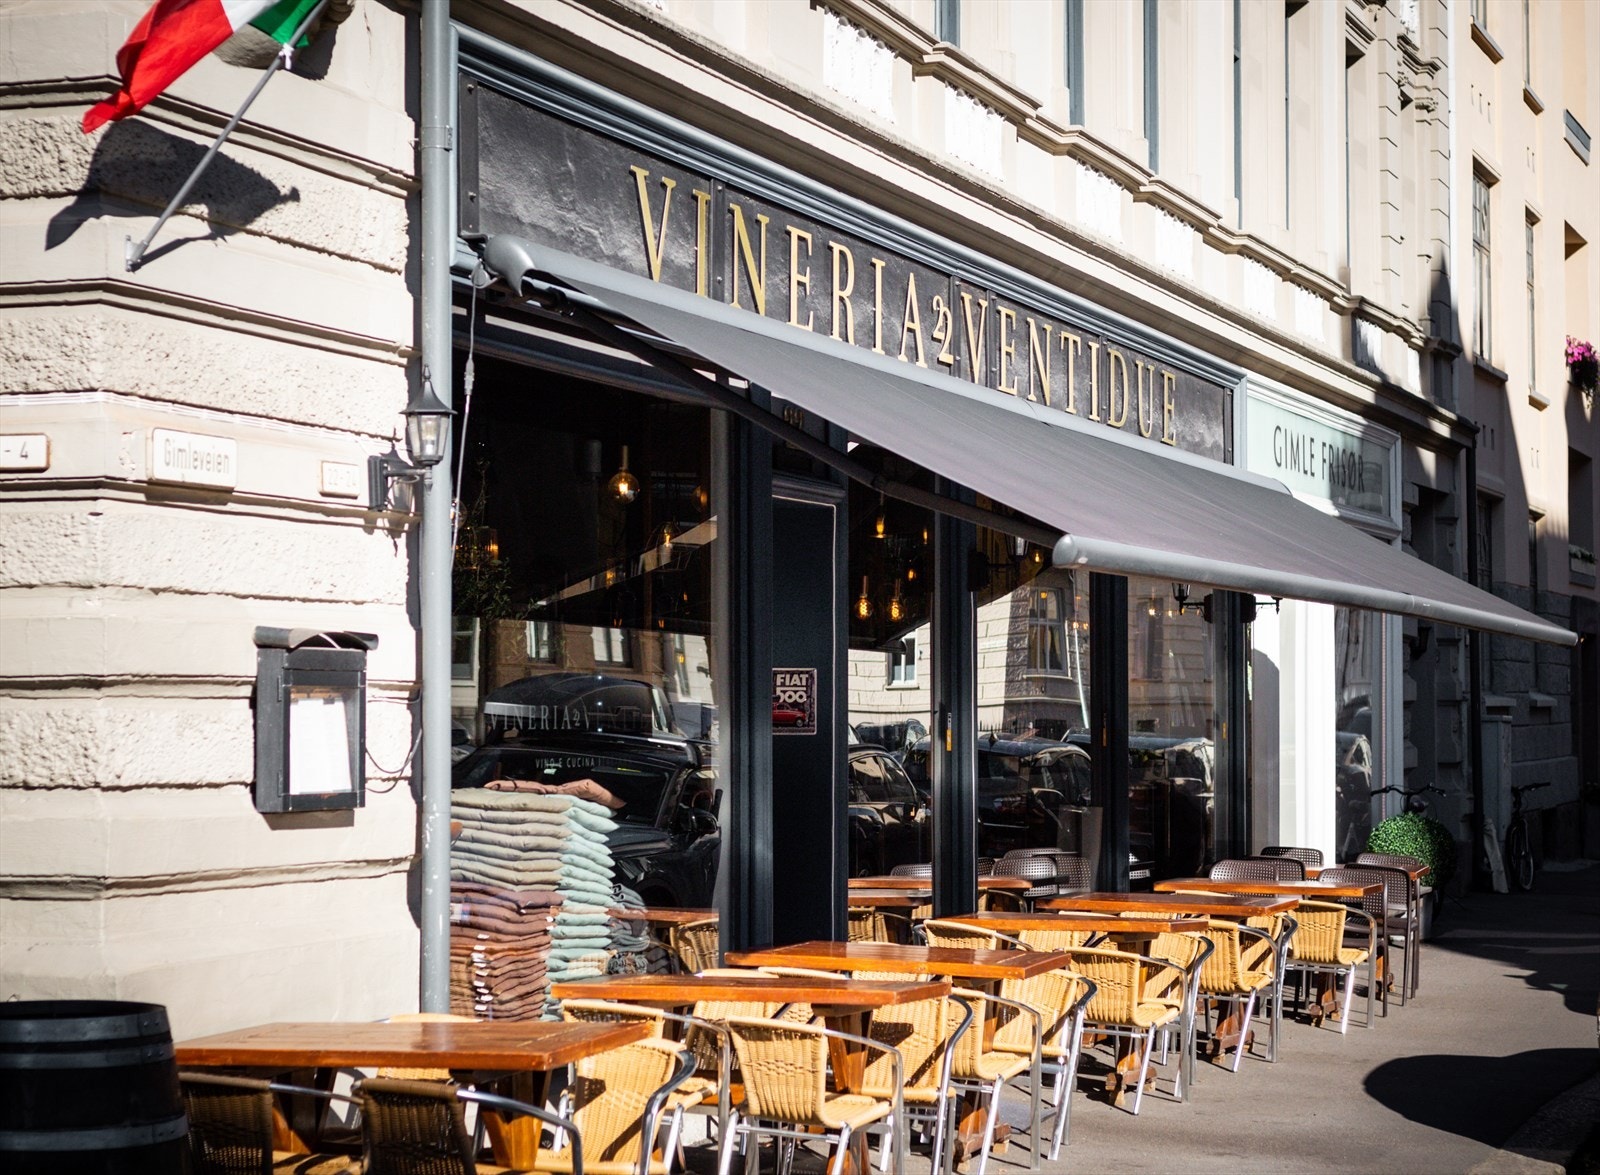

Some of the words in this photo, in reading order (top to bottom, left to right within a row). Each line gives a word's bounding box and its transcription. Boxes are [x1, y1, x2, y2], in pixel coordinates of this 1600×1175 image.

[630, 165, 928, 368] VINERIA
[960, 291, 1176, 446] VENTIDUE
[20, 441, 29, 461] 4
[164, 438, 230, 474] Gimleveien
[1273, 425, 1315, 477] GIMLE
[1321, 441, 1365, 493] FRISØR
[776, 674, 809, 686] FIAT
[776, 687, 807, 703] 500
[489, 703, 572, 730] VINERIA
[535, 757, 556, 769] VINO
[566, 757, 595, 769] CUCINA
